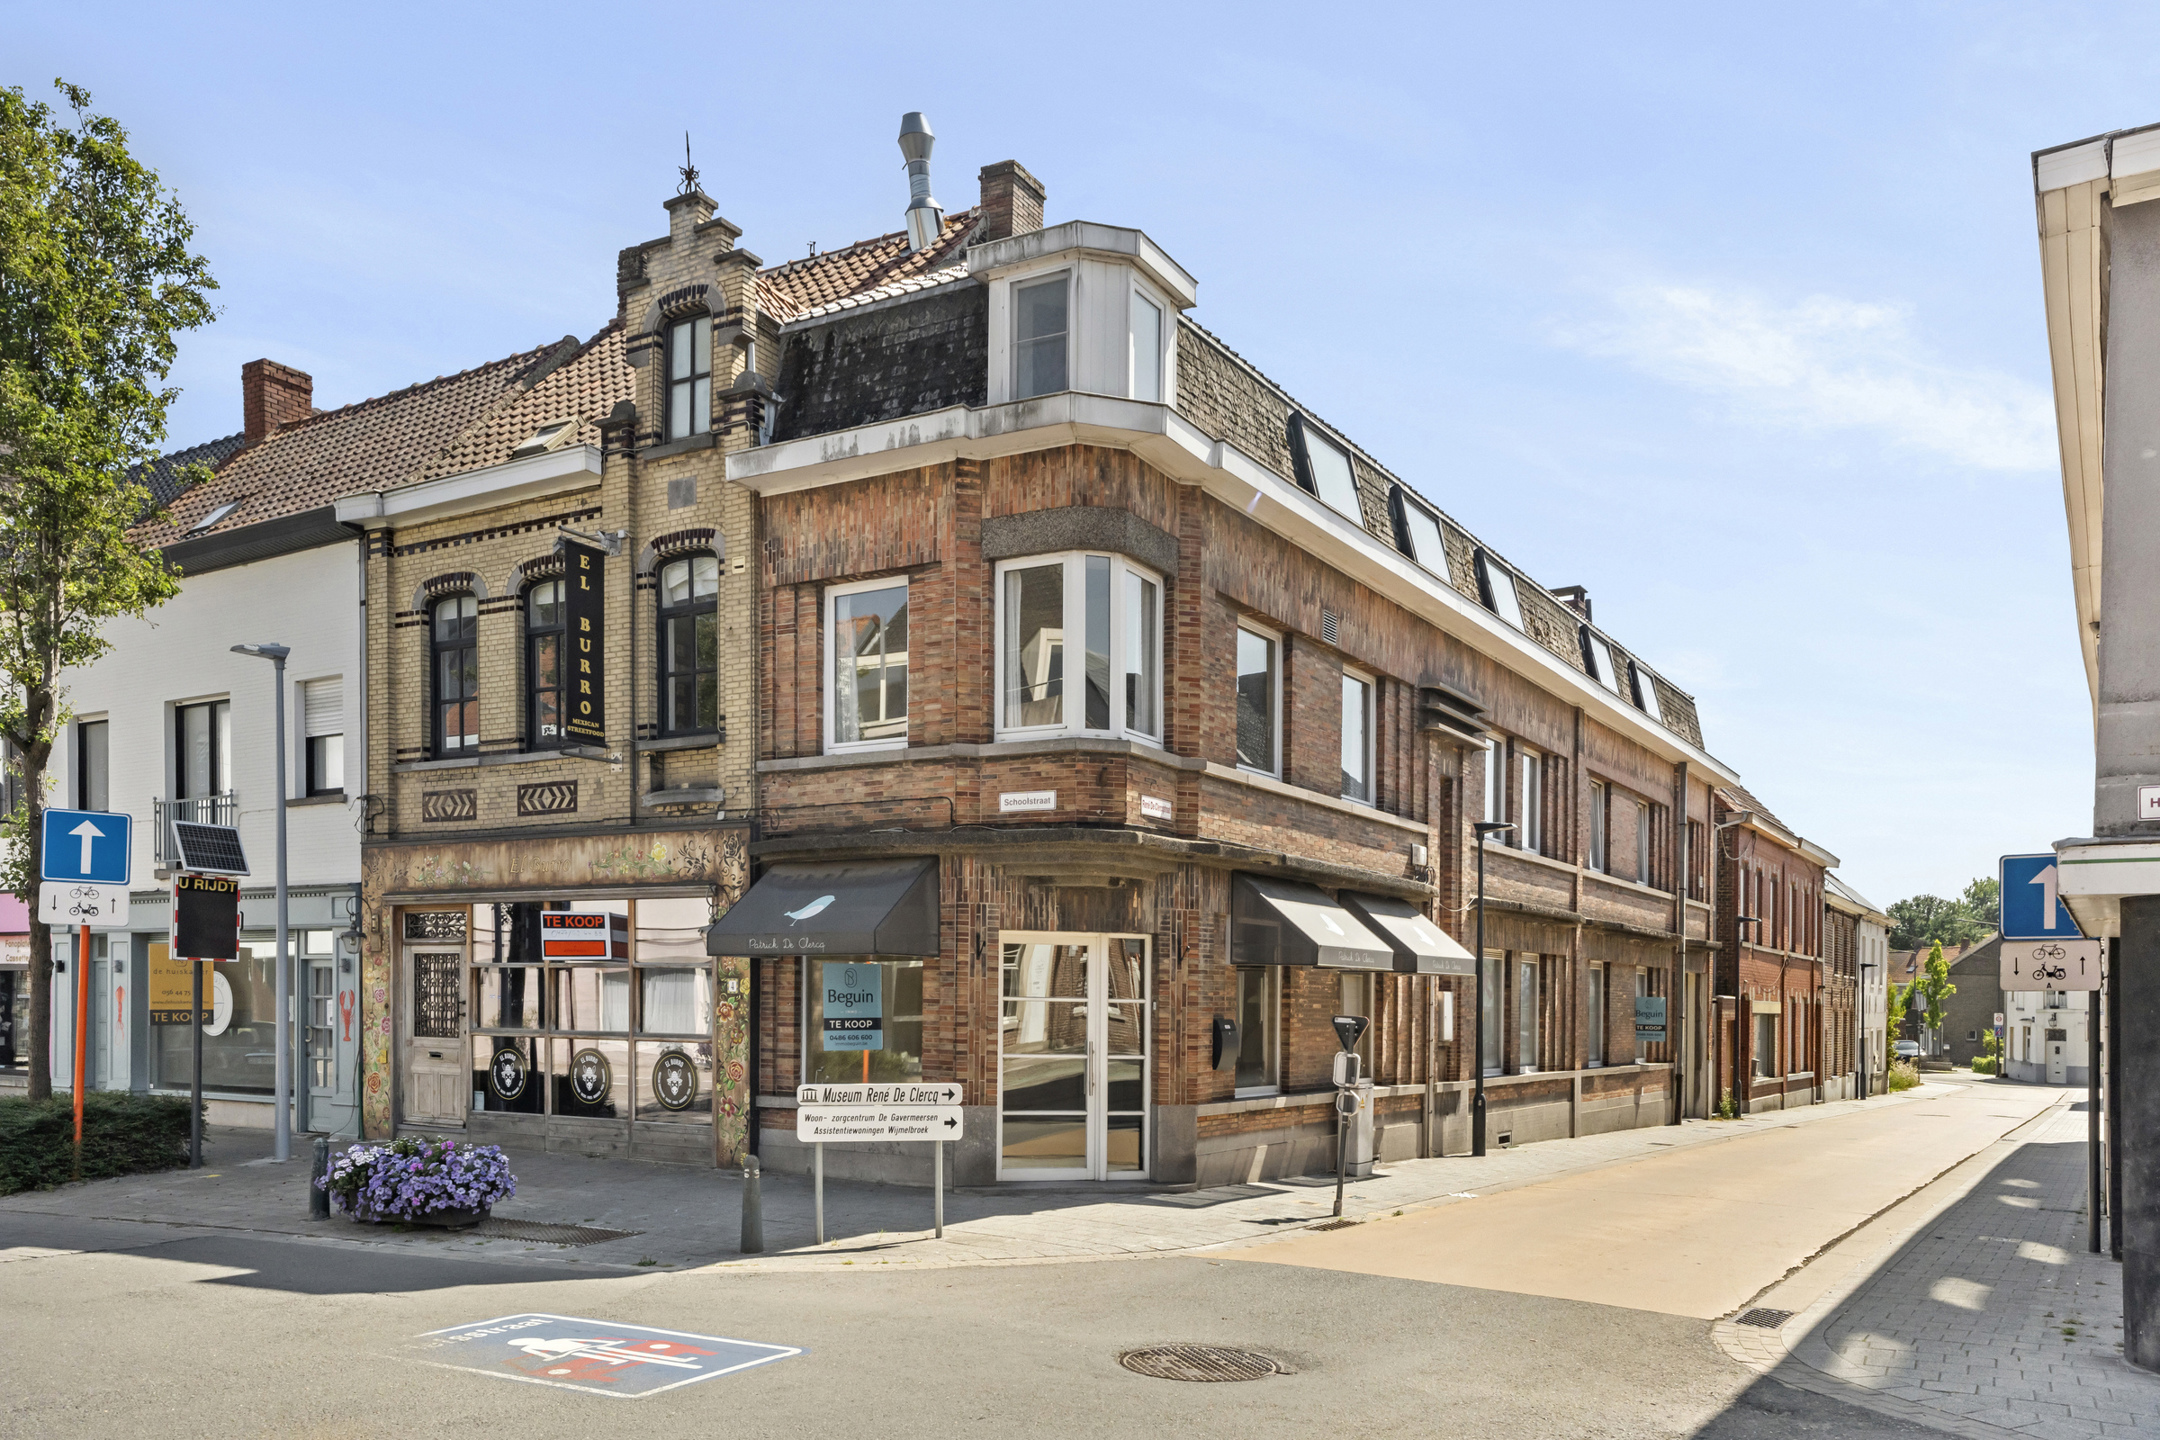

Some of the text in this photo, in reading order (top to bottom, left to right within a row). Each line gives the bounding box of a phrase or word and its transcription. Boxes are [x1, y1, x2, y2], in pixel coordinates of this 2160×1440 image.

[579, 554, 592, 715] EL BURRO
[572, 717, 600, 728] MEXICAN
[567, 725, 605, 738] STREETFOOD
[1004, 797, 1051, 806] Schoolstraat
[529, 856, 572, 874] Burro
[178, 877, 238, 893] U RIJDT
[544, 915, 604, 928] TE KOOP
[748, 937, 826, 953] Patrick De Clercq
[5, 953, 30, 962] Cassette
[828, 989, 874, 1008] Beguin
[152, 1012, 209, 1022] TE KOP
[1635, 1010, 1663, 1020] Beguin
[829, 1020, 873, 1029] TE KOOP
[822, 1087, 939, 1105] Museum René De Clercq
[804, 1113, 939, 1123] Woon- zorgcentrum De Gavermeersen
[814, 1126, 929, 1136] Assistentiewoningen Wijmelbroek
